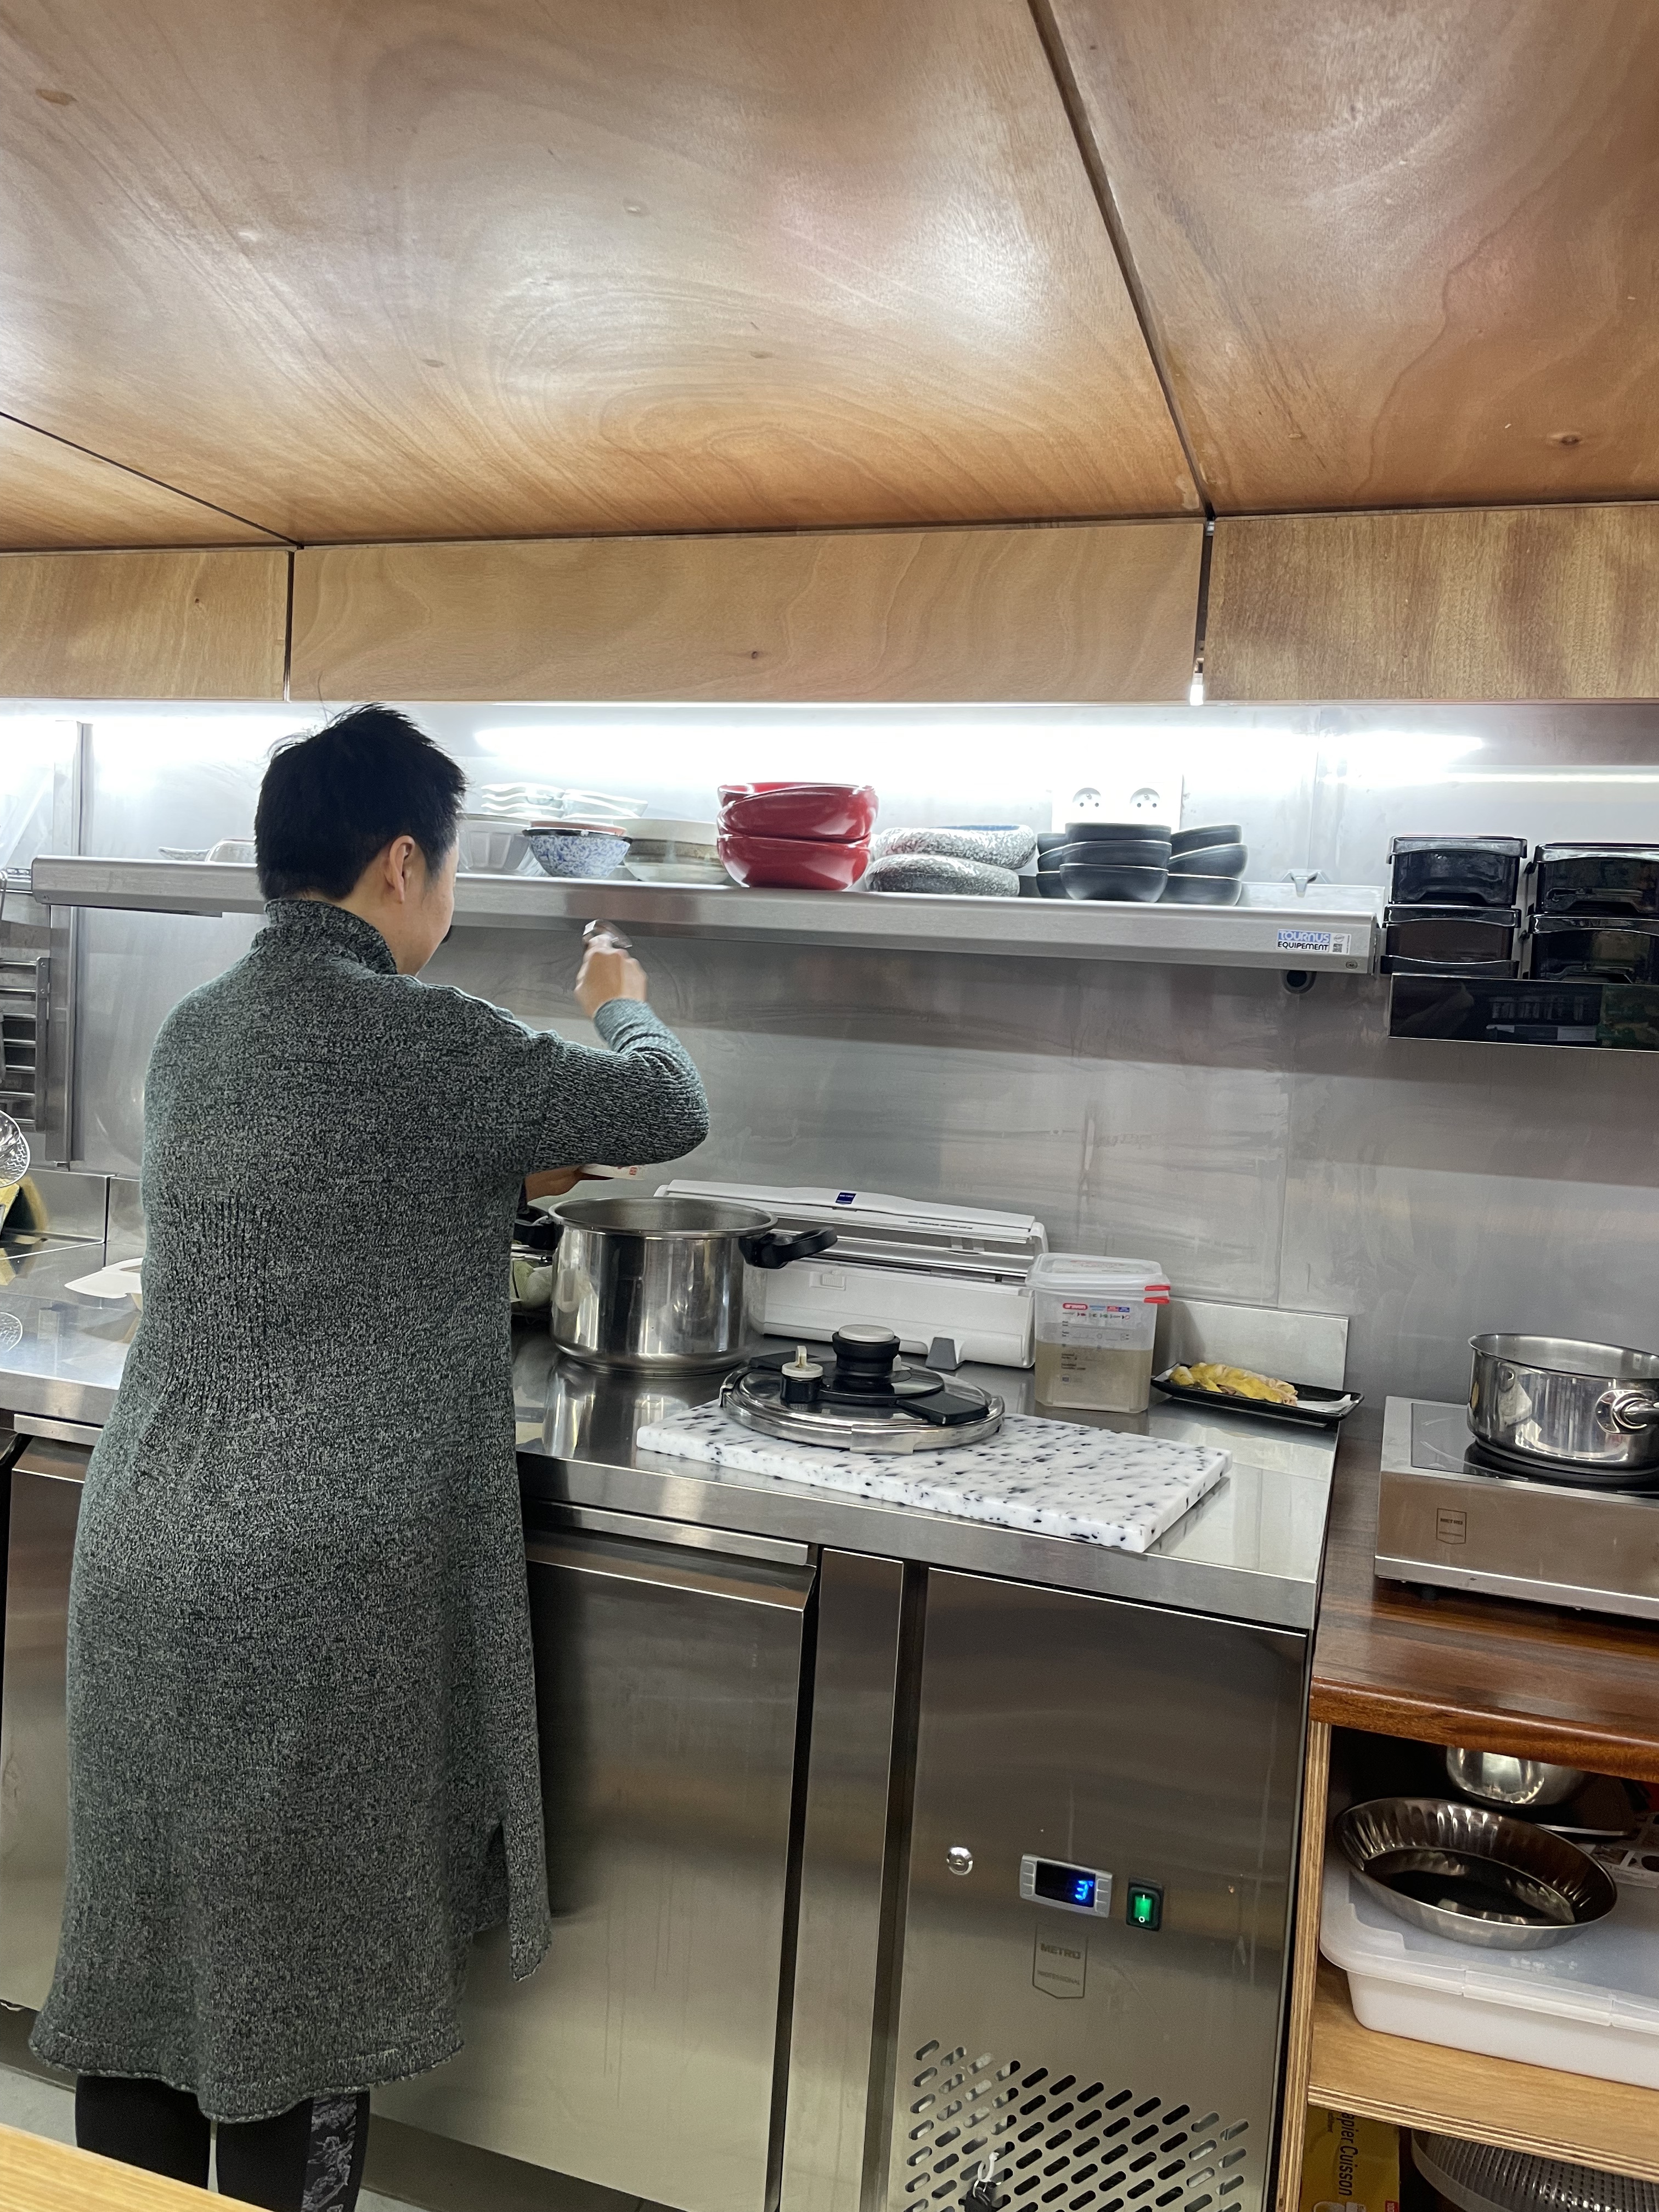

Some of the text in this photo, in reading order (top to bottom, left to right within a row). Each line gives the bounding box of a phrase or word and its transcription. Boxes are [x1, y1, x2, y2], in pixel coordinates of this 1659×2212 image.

[1278, 930, 1330, 943] TOURNUS
[1278, 941, 1329, 951] EQUIPEMENT
[1041, 1943, 1081, 1959] METRO
[1336, 2112, 1359, 2196] apier Cuisson
